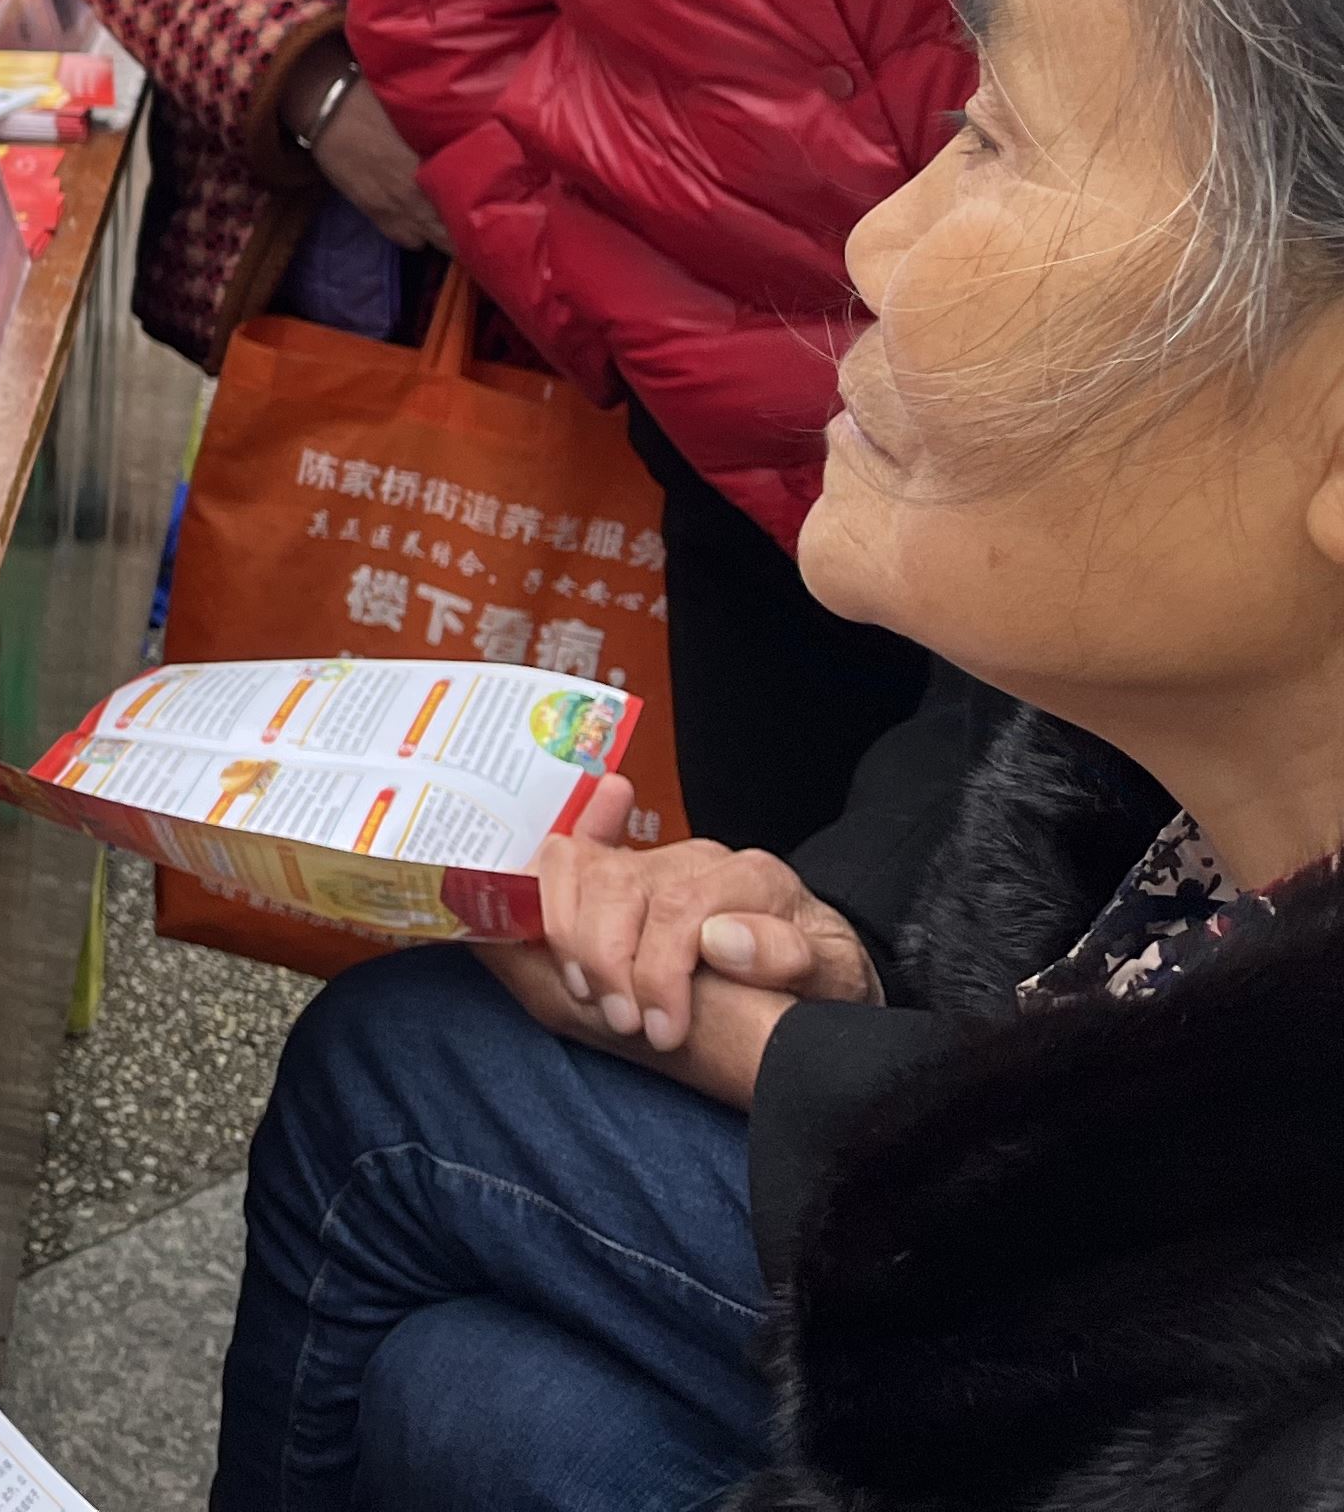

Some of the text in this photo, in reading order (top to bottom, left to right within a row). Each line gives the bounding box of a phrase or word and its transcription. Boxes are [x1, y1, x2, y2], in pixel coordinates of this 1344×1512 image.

[297, 448, 667, 571] 陈家桥街道养老服务
